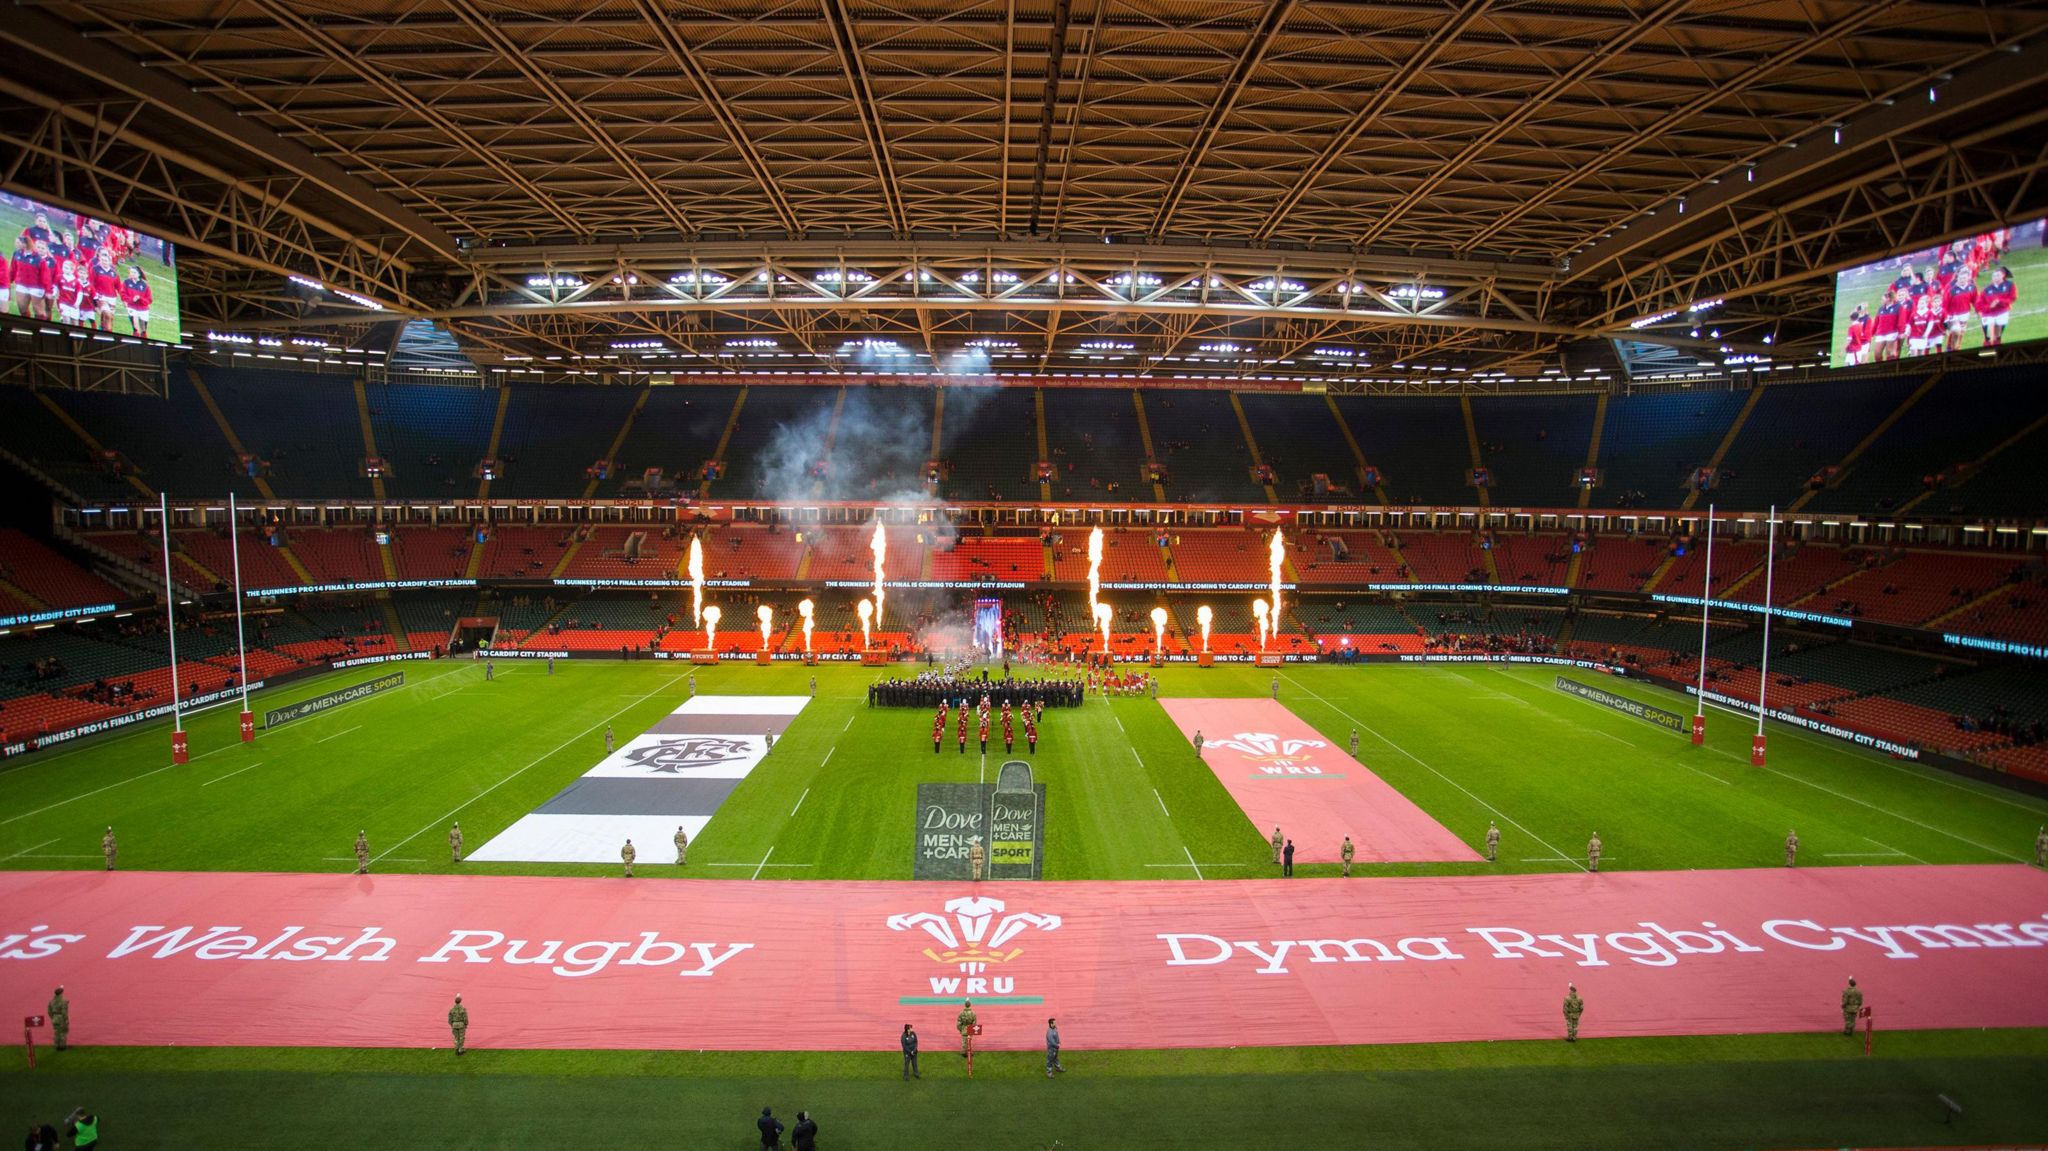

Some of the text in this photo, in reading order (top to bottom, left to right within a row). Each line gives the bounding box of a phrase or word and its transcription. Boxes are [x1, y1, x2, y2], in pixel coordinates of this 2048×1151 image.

[260, 587, 298, 596] GUINNESS
[17, 616, 29, 624] TO
[30, 611, 64, 622] CARDIFF
[65, 608, 82, 617] CITY
[82, 604, 115, 614] STADIUM
[1666, 596, 1700, 606] GUINNESS
[1723, 602, 1741, 611] FINAL
[1782, 610, 1806, 620] CARDIFF
[1807, 613, 1822, 622] CITY
[1822, 615, 1852, 627] STADIUM
[1943, 634, 1960, 644] THE
[1961, 637, 2006, 652] GUINNESS
[2008, 644, 2041, 656] PRO14
[346, 656, 384, 666] GUINNESS
[270, 675, 402, 725] Dove MEN+CARE SPORT
[1558, 678, 1680, 728] Dove MEN+CARE SPORT
[4, 743, 26, 756] THE
[77, 722, 109, 737] PRO14
[110, 715, 135, 728] FINAL
[136, 712, 144, 720] IS
[179, 701, 188, 710] TO
[190, 692, 219, 706] CARDIFF
[220, 689, 234, 698] CITY
[1686, 686, 1696, 694] THE
[1727, 697, 1748, 709] PRO14
[1777, 711, 1807, 728] COMING
[1808, 720, 1819, 730] TO
[1820, 724, 1853, 740] CARDIFF
[1855, 733, 1875, 746] CITY
[1875, 739, 1918, 759] STADIUM
[1259, 766, 1322, 774] WRU
[924, 805, 982, 829] Dove
[994, 804, 1032, 820] Dove
[994, 824, 1019, 832] MEN
[994, 832, 1031, 840] +CARE
[924, 835, 962, 847] MEN
[924, 847, 970, 859] +CAR
[993, 848, 1031, 857] SPORT
[106, 926, 397, 962] Welsh
[416, 930, 755, 976] Rugby
[1156, 933, 1465, 974] Dyma
[1465, 921, 1764, 967] Rygbi
[929, 977, 1014, 994] WRU
